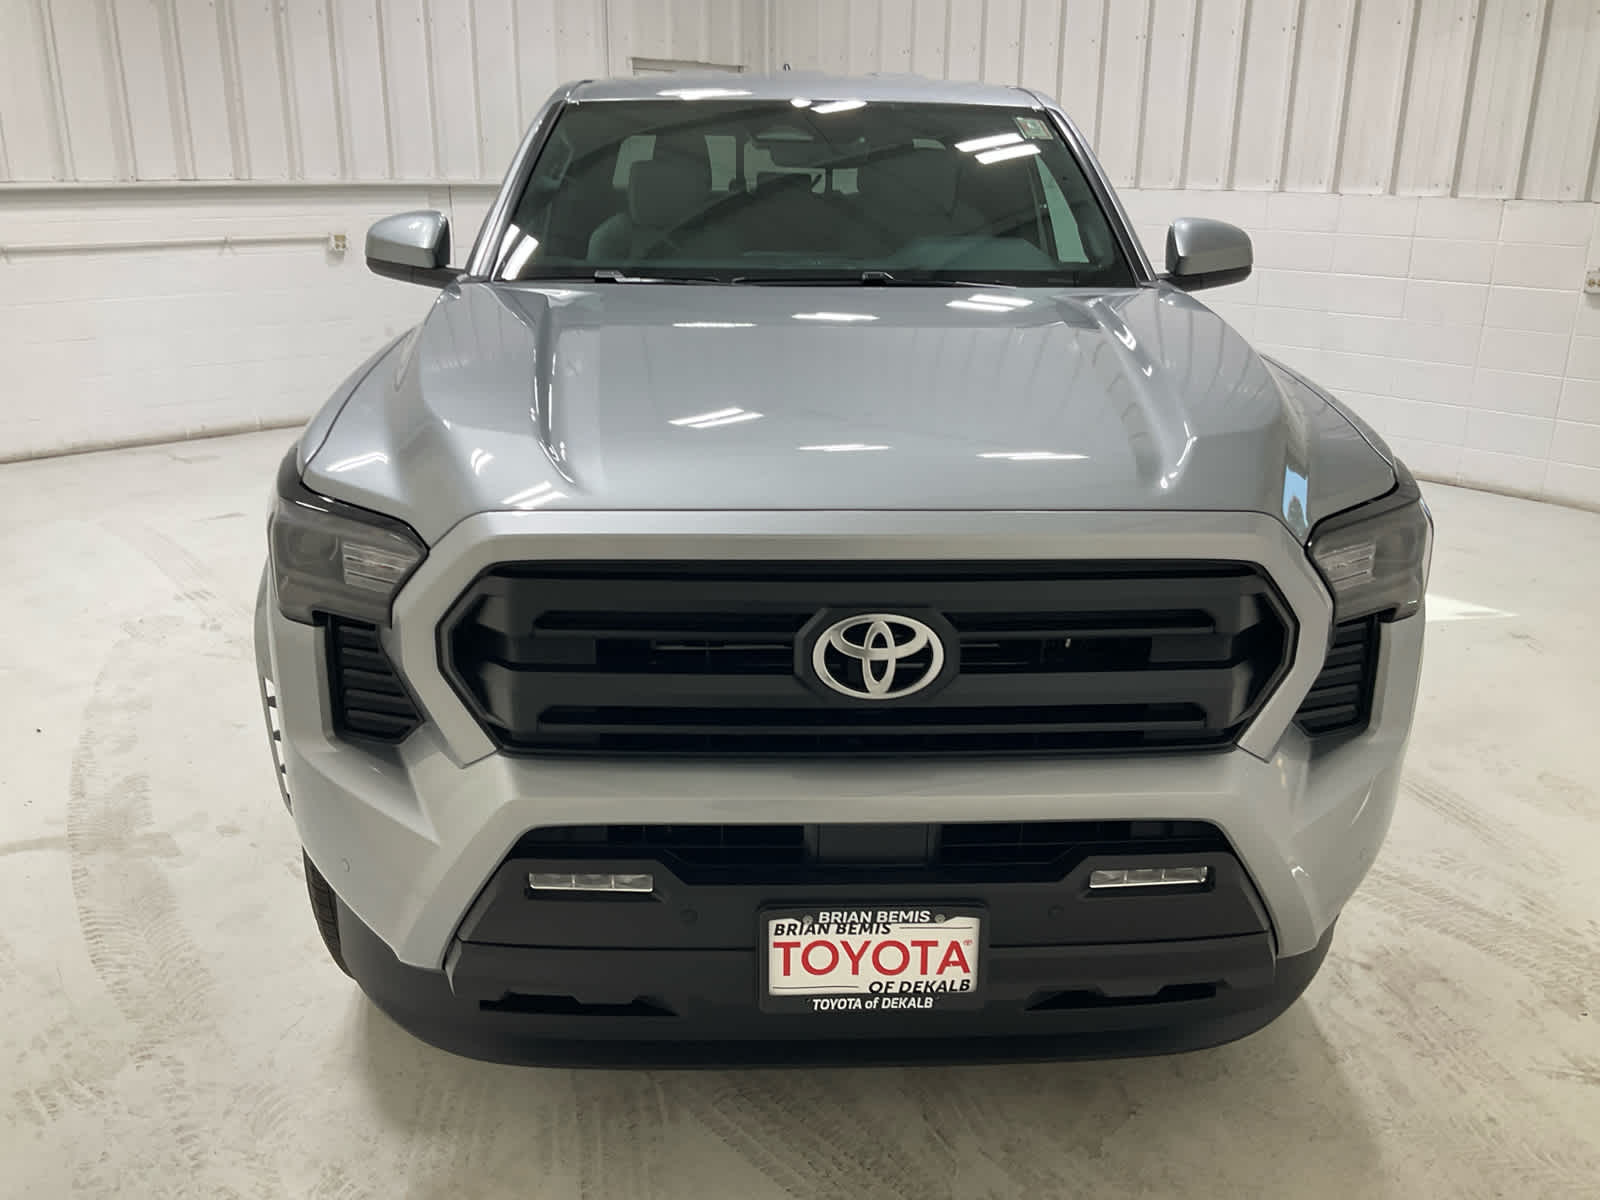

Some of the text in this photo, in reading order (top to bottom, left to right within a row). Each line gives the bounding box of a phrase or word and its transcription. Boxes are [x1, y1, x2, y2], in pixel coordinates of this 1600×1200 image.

[818, 910, 931, 923] BRIAN BEMIS
[774, 922, 891, 936] BRIAN BEMIS
[773, 939, 970, 976] TOYOTA
[868, 979, 970, 994] OF DEKALB
[813, 997, 934, 1010] TOYOTA of DEKALB
